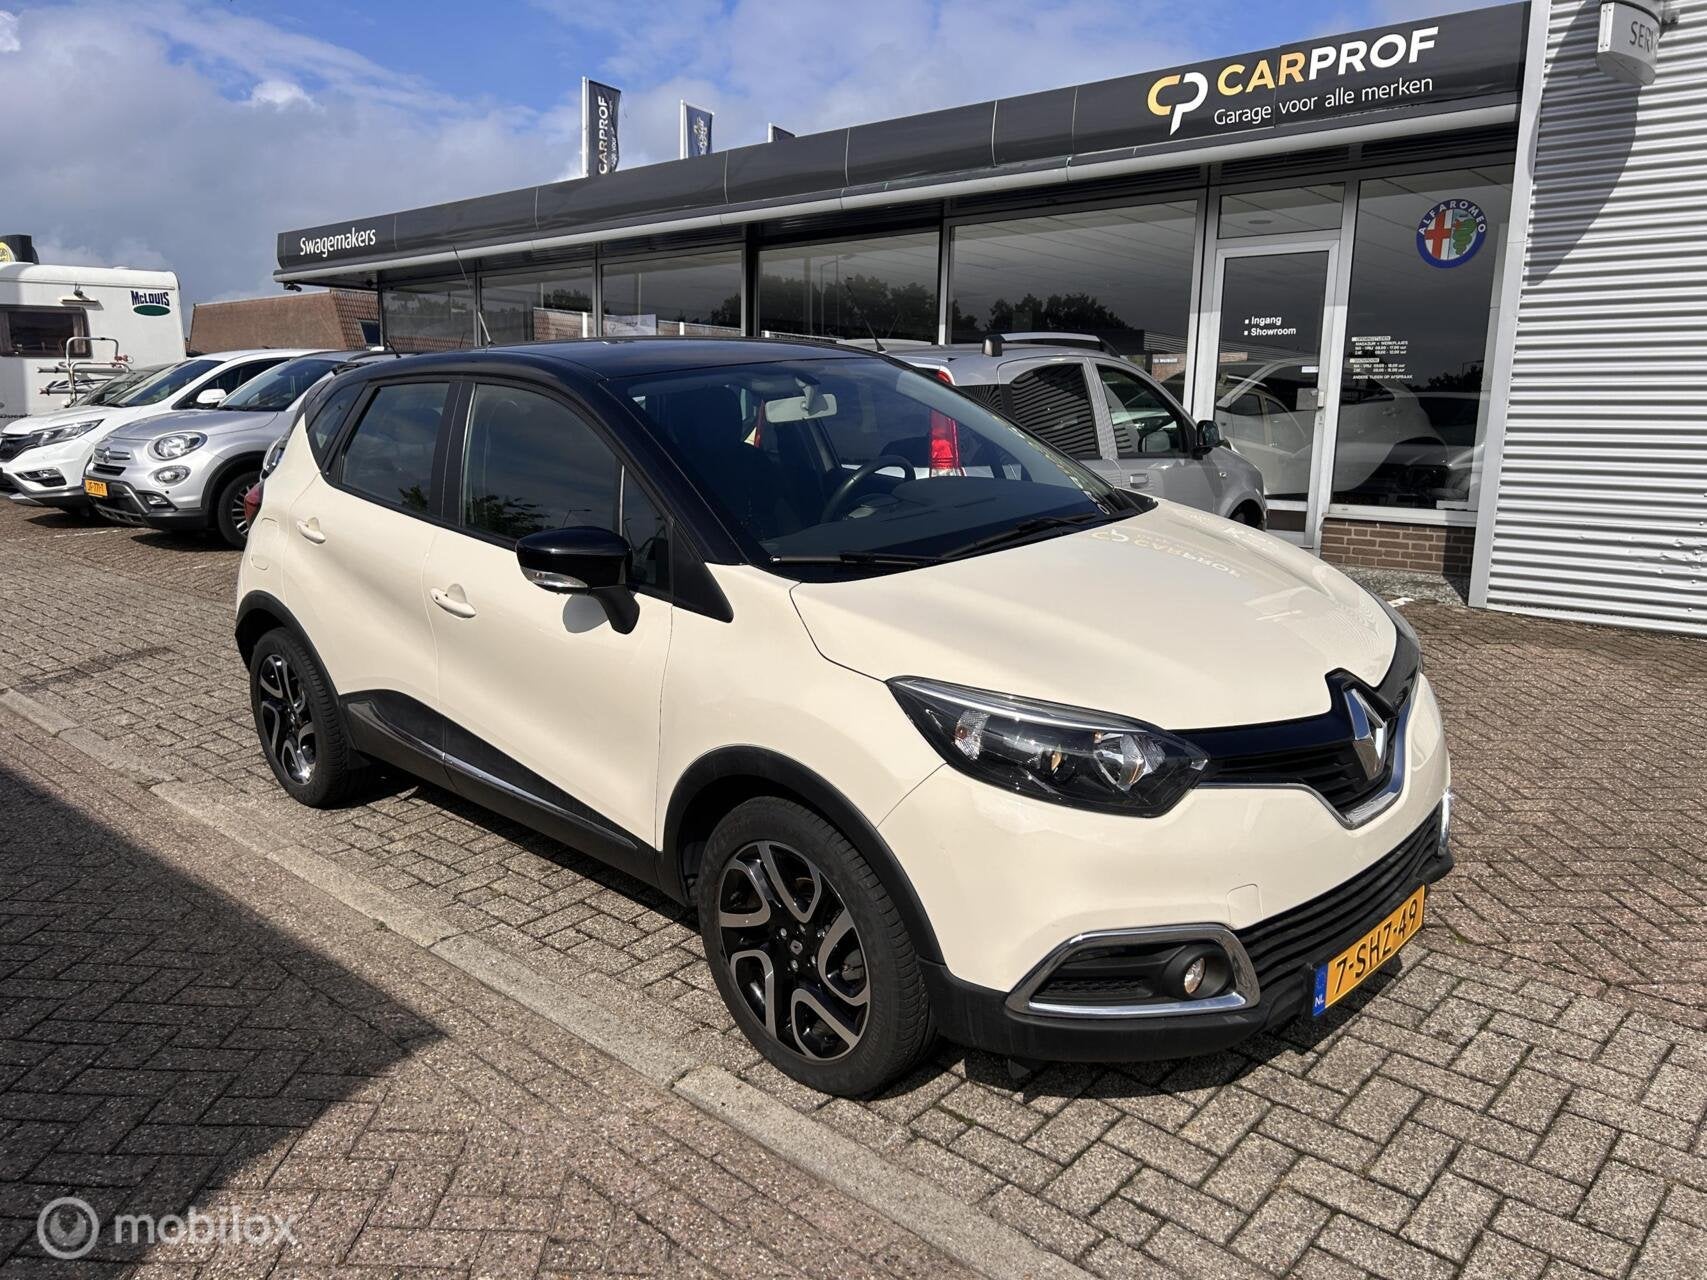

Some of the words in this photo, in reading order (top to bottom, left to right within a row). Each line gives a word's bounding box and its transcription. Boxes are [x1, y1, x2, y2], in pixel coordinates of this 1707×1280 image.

[1216, 26, 1439, 97] CARPROF
[1213, 101, 1273, 126] Garage
[1278, 95, 1318, 115] voor
[1324, 86, 1355, 109] alle
[1361, 76, 1434, 102] merken
[597, 95, 609, 175] CARPROF
[299, 226, 377, 258] Swagemakers
[1250, 328, 1296, 336] Showroom
[1251, 316, 1282, 326] Ingang
[1335, 898, 1418, 995] 7-SHZ-49
[1314, 994, 1325, 1008] NL
